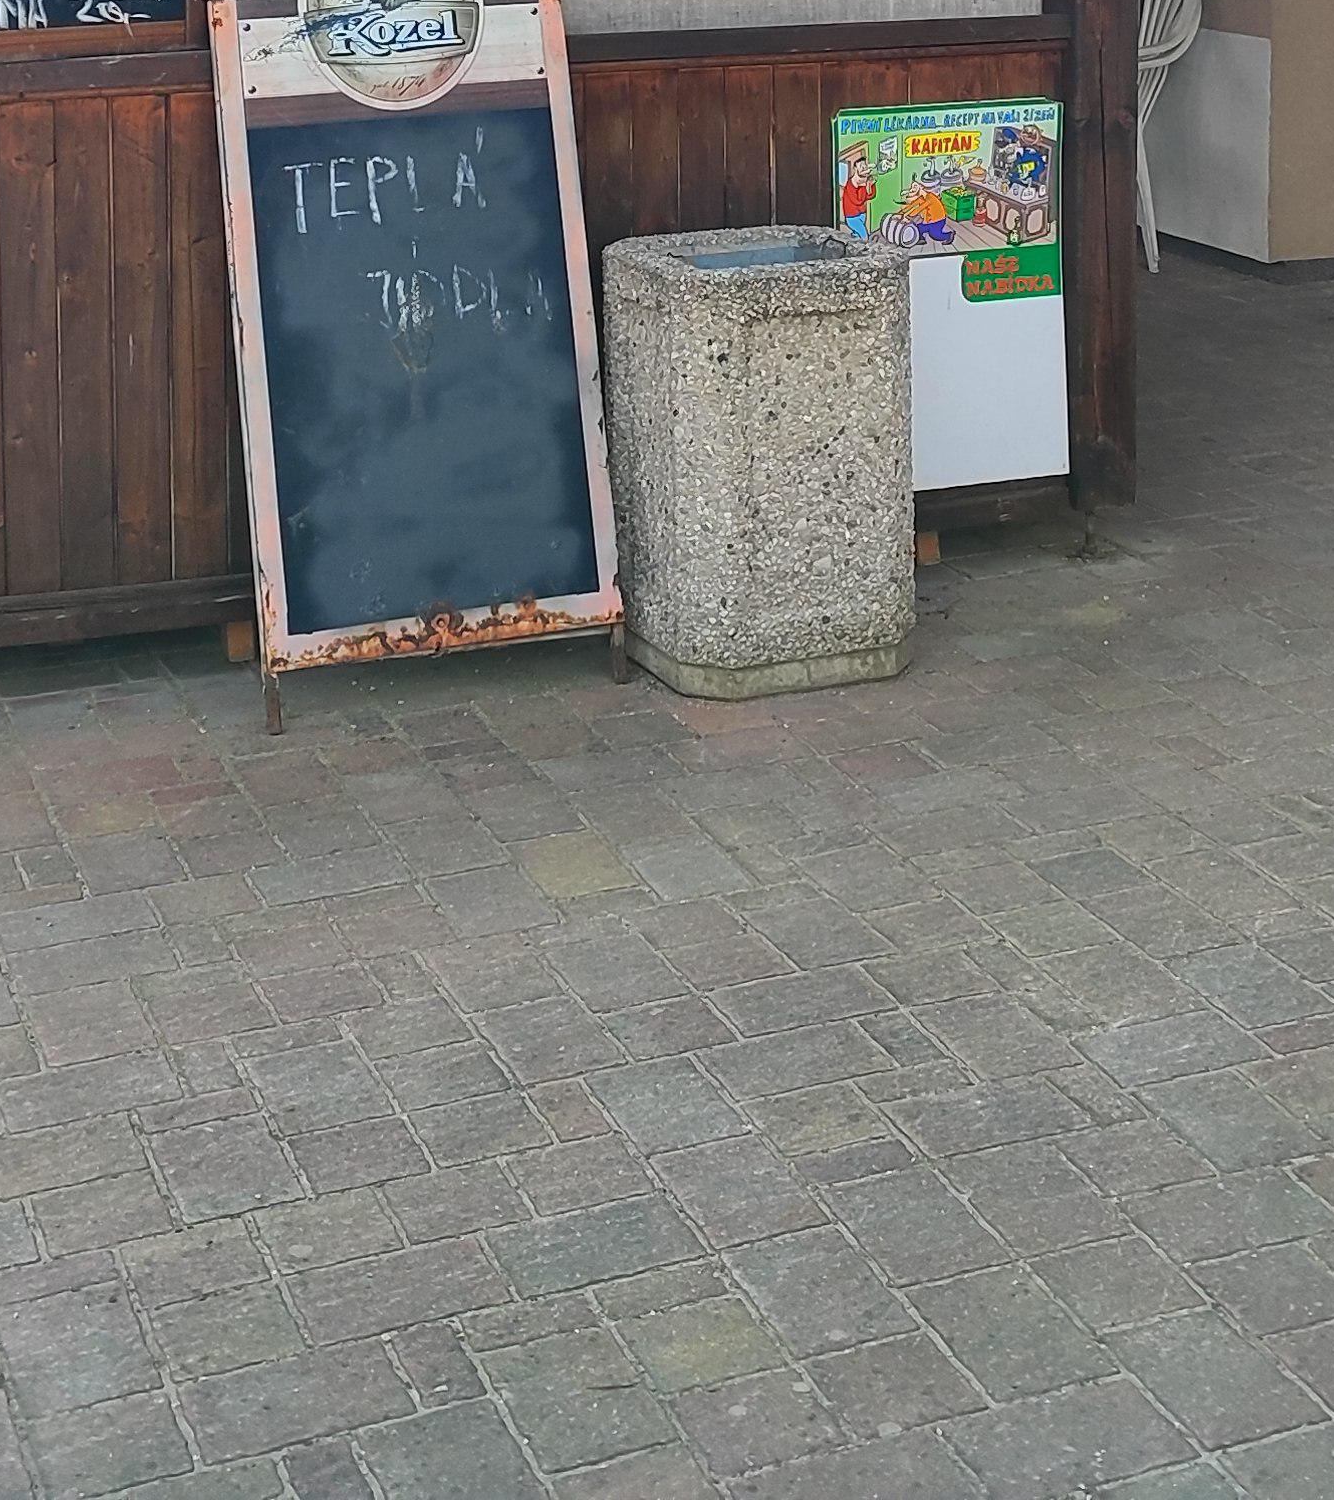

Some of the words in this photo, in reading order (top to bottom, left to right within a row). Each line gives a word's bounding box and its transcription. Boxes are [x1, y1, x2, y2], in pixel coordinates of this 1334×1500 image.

[327, 8, 466, 57] Kozel
[943, 111, 980, 128] RECEPT
[911, 133, 972, 155] KAPITÁN
[283, 127, 486, 234] TEPLÁ
[966, 254, 1019, 275] NAŠE
[966, 274, 1054, 296] NABÍDKA
